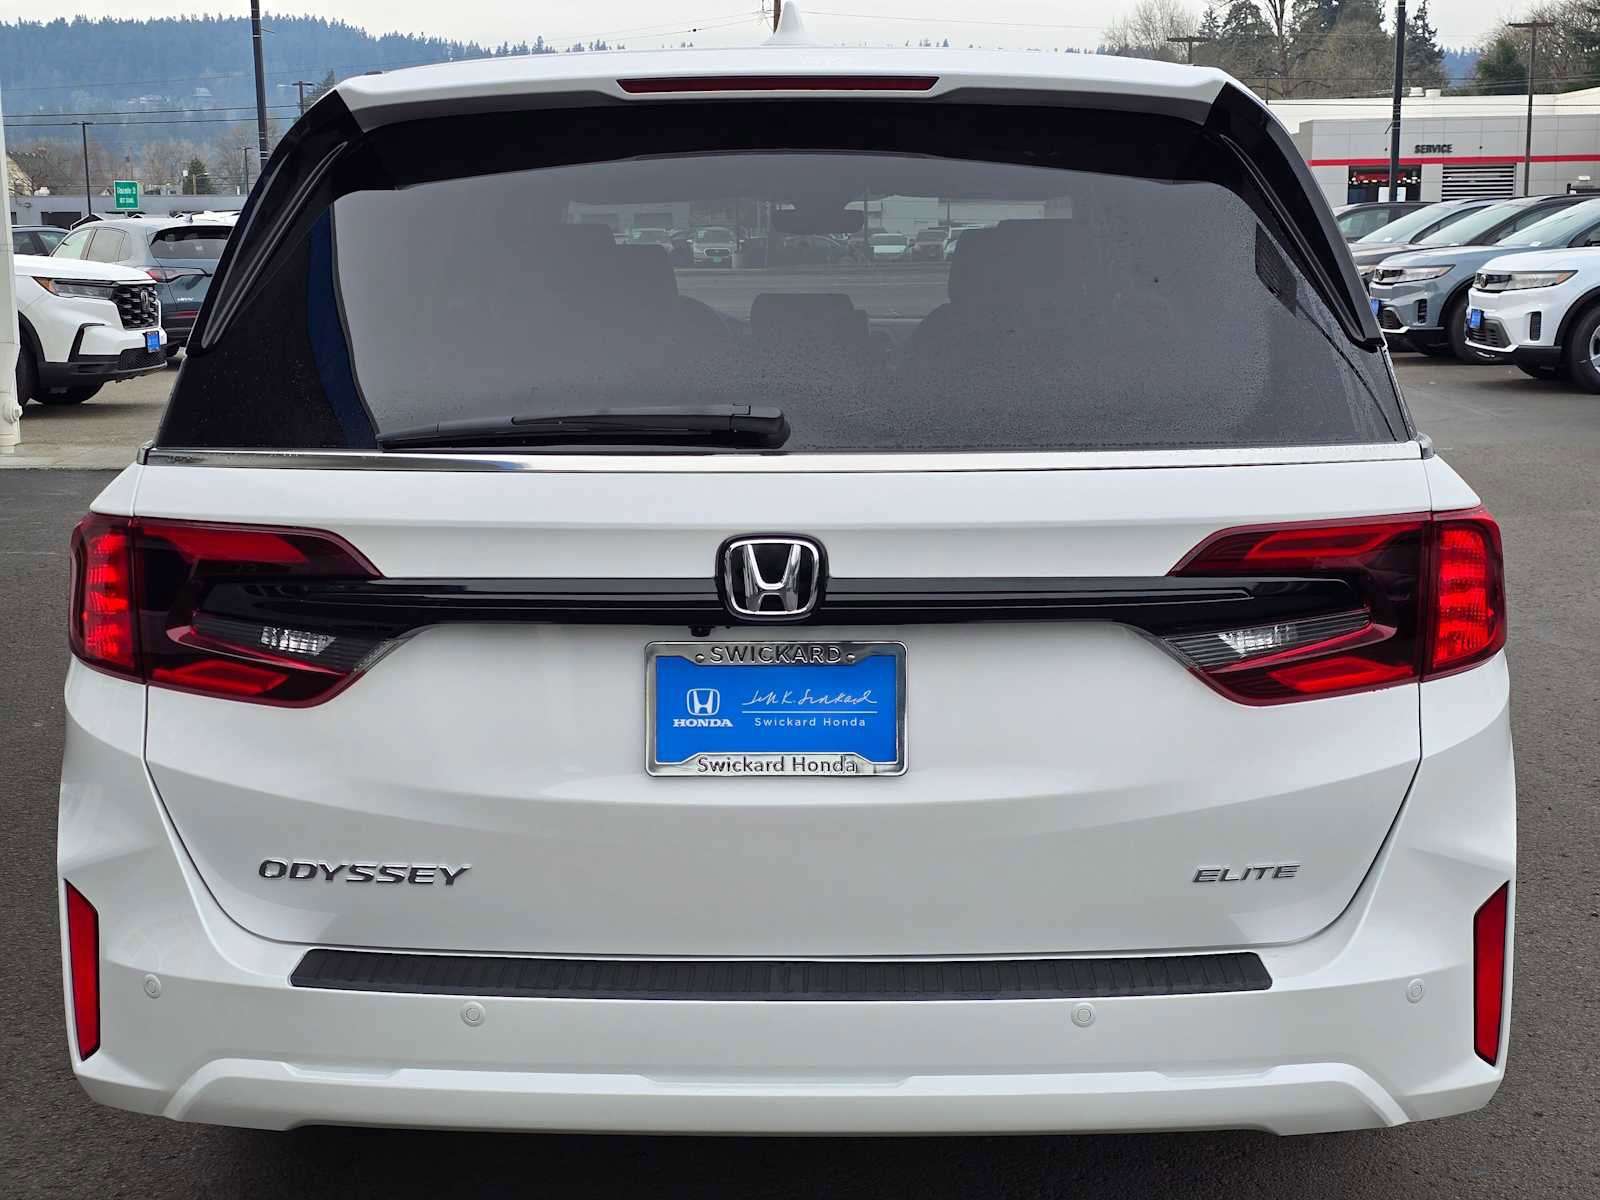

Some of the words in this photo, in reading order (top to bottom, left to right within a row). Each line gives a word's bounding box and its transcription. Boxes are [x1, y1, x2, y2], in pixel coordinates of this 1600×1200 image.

[1415, 144, 1453, 153] SERVICE
[709, 645, 842, 664] SWICKARD
[673, 718, 733, 728] HONDA
[754, 717, 816, 727] Swickard
[823, 717, 866, 727] Honda
[698, 756, 784, 774] Swickard
[792, 755, 858, 774] Honda
[258, 859, 472, 886] ODYSSEY
[1193, 861, 1302, 883] ELITE
